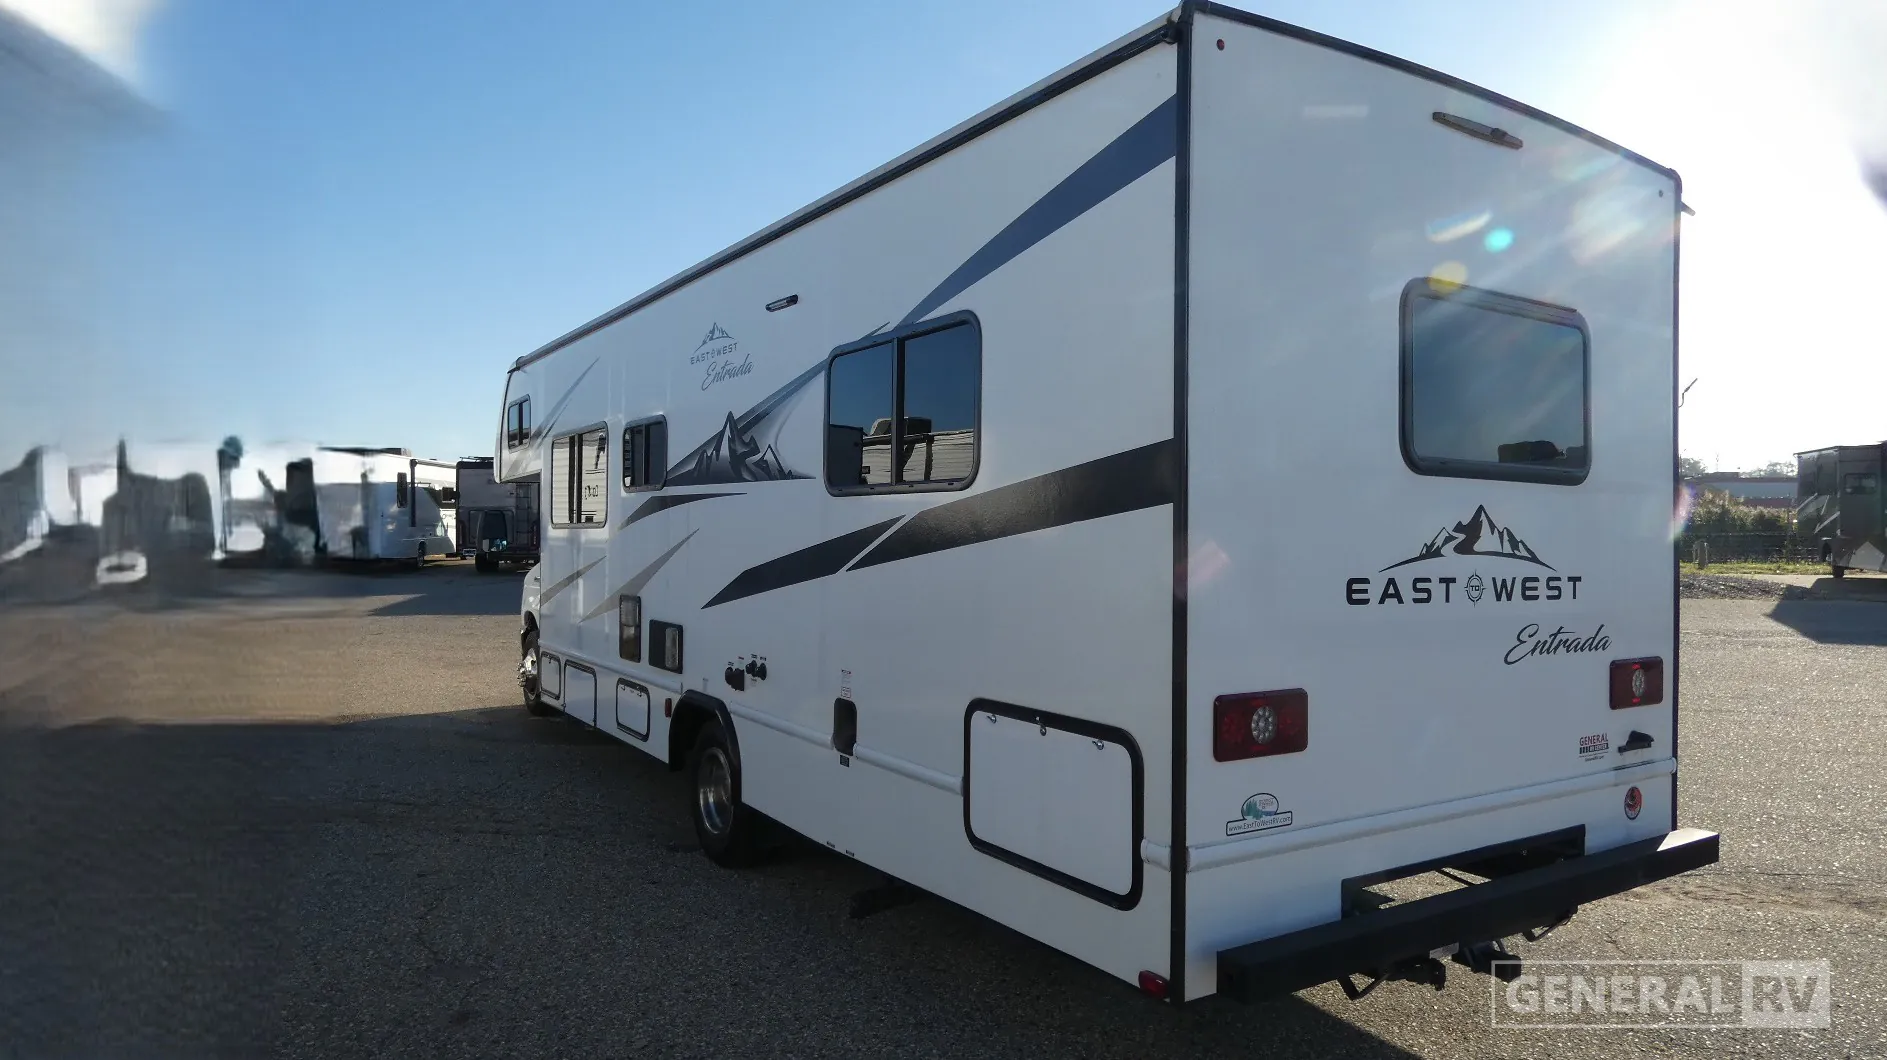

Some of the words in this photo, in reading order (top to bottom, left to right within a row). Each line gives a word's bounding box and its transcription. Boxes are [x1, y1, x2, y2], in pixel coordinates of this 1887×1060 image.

[690, 352, 710, 365] EAST
[716, 343, 738, 356] WEST
[701, 353, 753, 391] Entrada
[1345, 577, 1457, 606] EAST
[1491, 576, 1582, 602] WEST
[1503, 623, 1612, 665] Entrada
[1579, 732, 1608, 747] GENERAL
